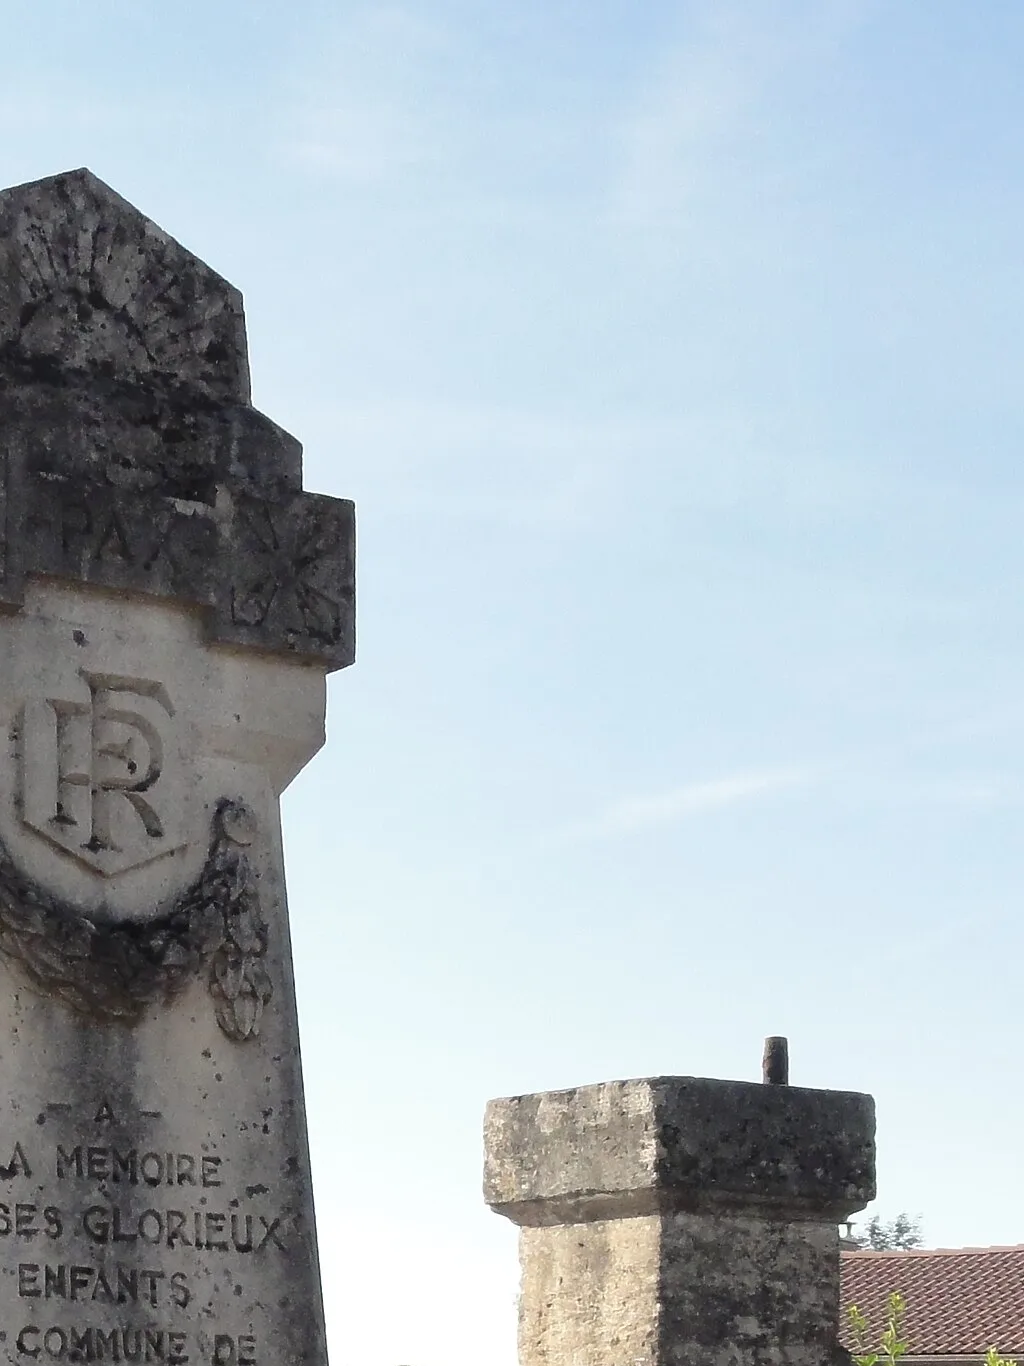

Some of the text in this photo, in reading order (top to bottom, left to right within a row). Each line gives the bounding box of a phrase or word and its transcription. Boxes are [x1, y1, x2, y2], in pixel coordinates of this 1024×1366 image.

[92, 1097, 120, 1124] A
[55, 1143, 224, 1188] MEMOIRE
[82, 1205, 288, 1253] GLORIEUX
[17, 1263, 192, 1309] ENFANTS
[15, 1324, 189, 1366] COMMUNE
